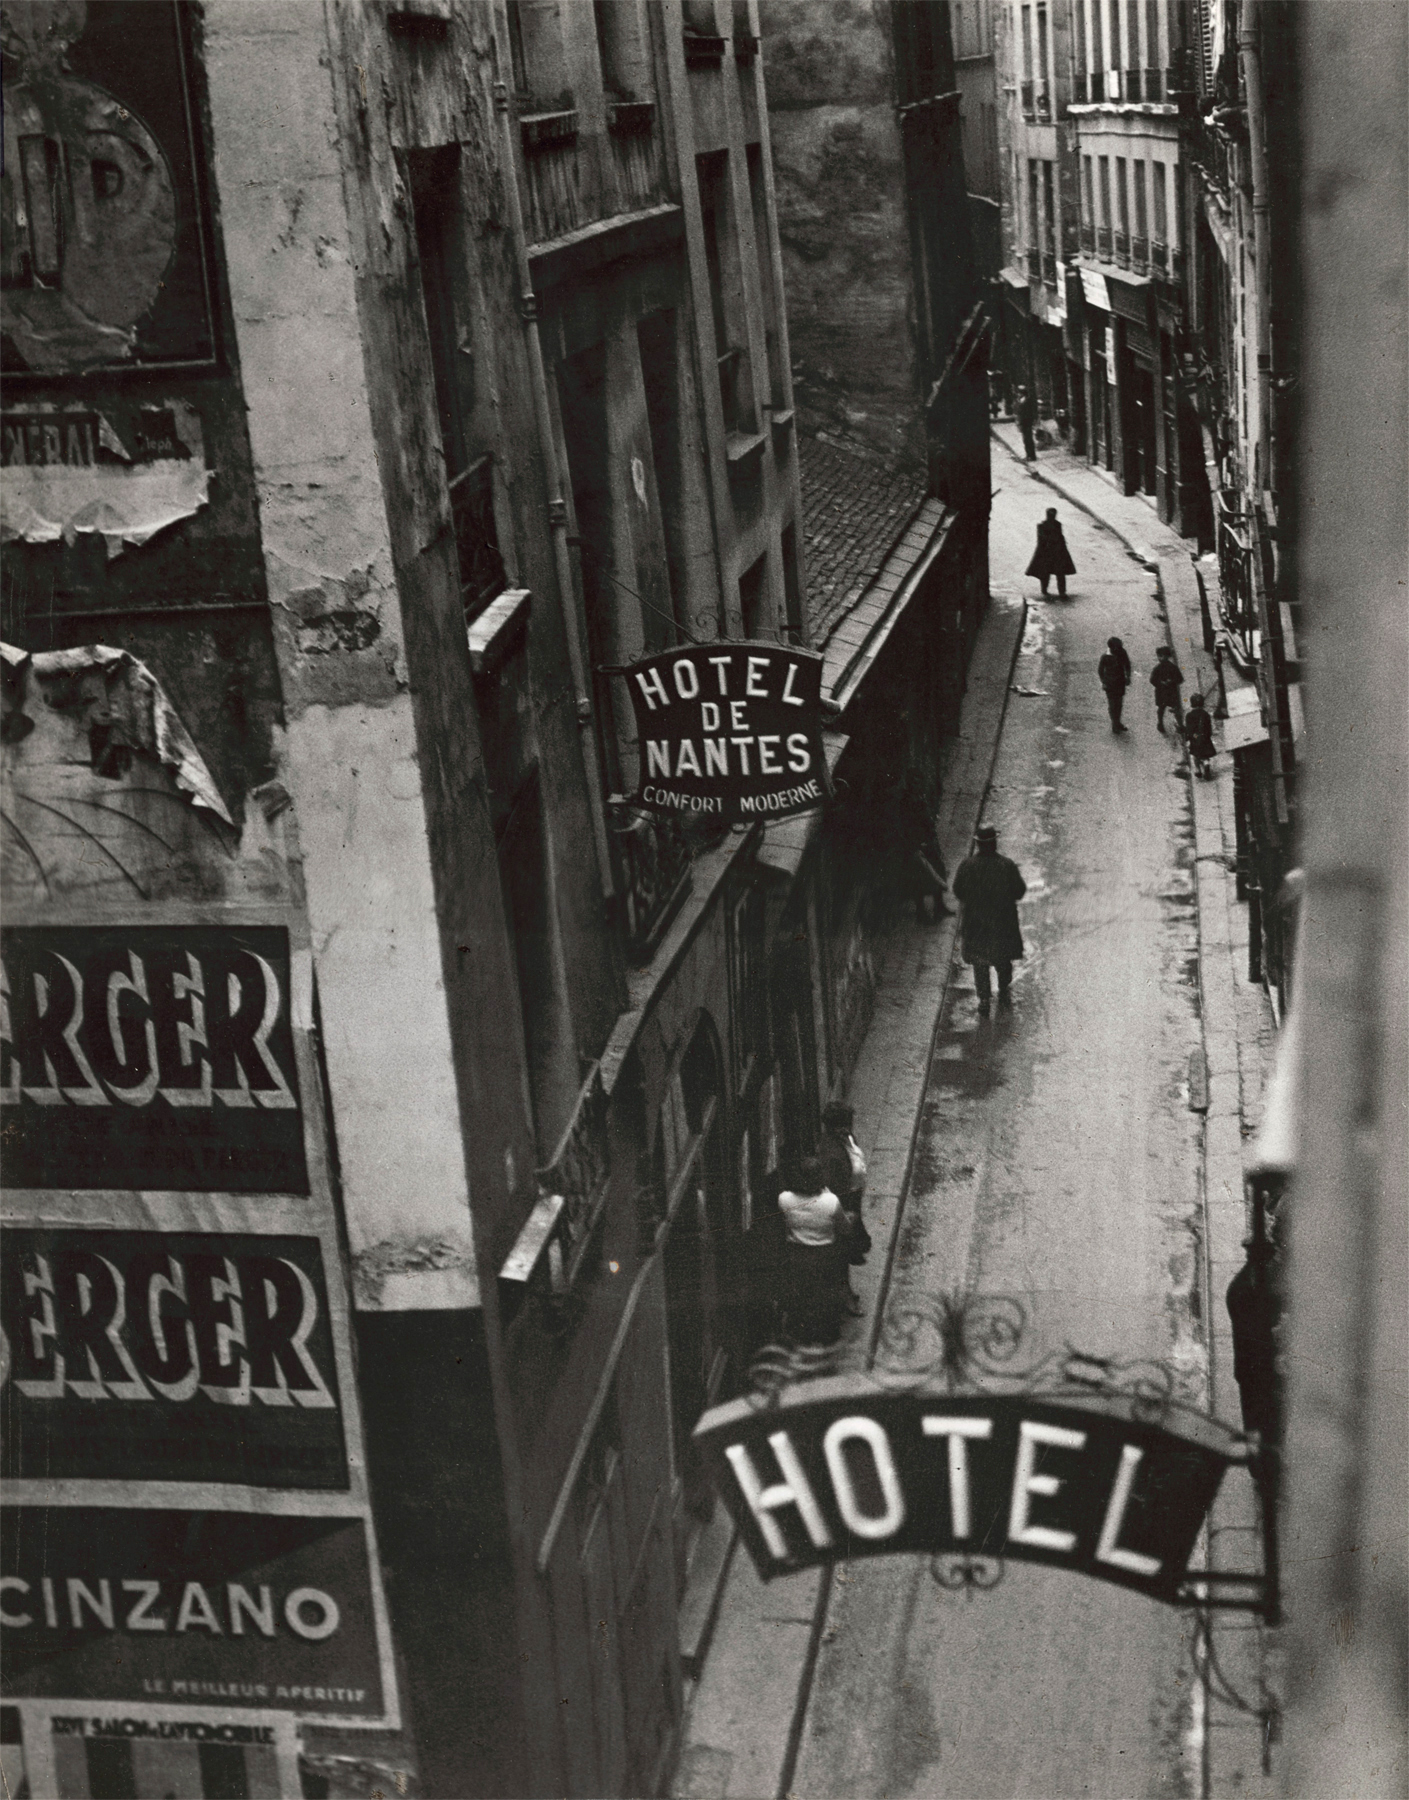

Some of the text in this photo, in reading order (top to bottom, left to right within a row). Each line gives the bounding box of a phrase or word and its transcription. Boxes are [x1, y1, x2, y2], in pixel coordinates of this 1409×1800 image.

[635, 656, 805, 710] HOTEL
[701, 701, 750, 731] DE
[646, 733, 811, 779] NANTES
[643, 779, 823, 813] CONFORT MODERNE
[0, 1250, 337, 1408] ERGER
[725, 1416, 1162, 1577] HOTEL
[0, 1576, 340, 1640] CINZANO
[143, 1678, 164, 1694] LE
[172, 1680, 269, 1697] MEILLEUR
